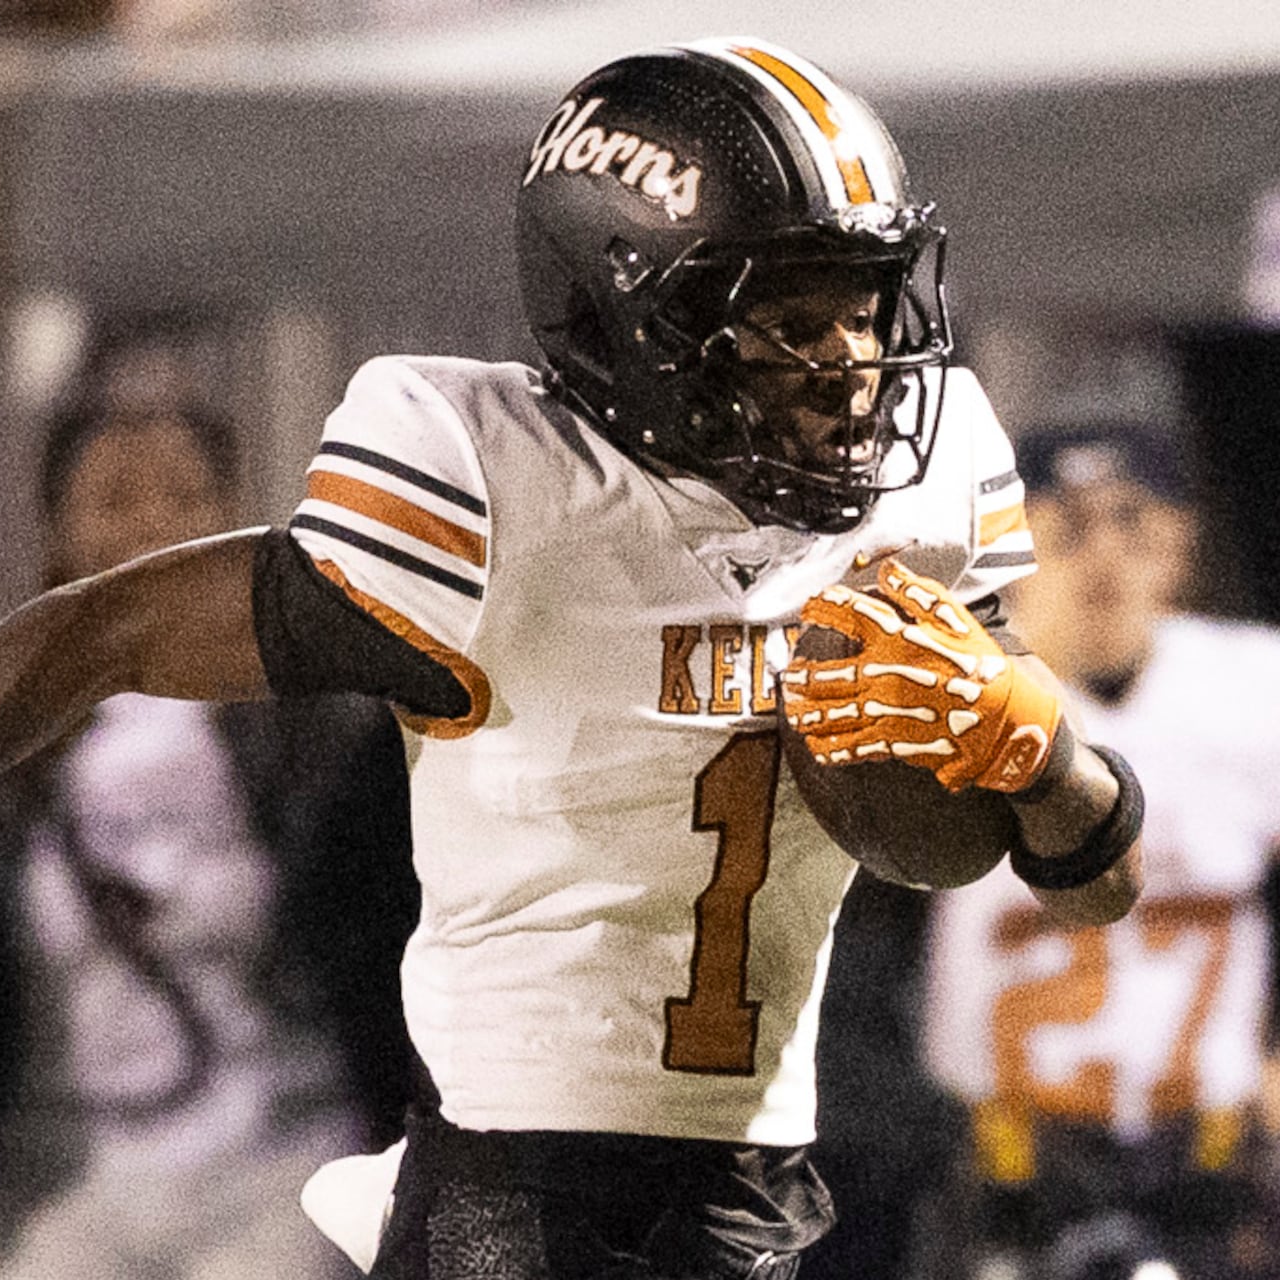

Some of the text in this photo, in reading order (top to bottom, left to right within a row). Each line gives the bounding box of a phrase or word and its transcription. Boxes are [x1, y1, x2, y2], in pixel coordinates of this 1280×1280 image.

[522, 97, 702, 221] Horns
[659, 624, 803, 716] KEL
[661, 729, 781, 1077] 1
[988, 893, 1238, 1122] 27
